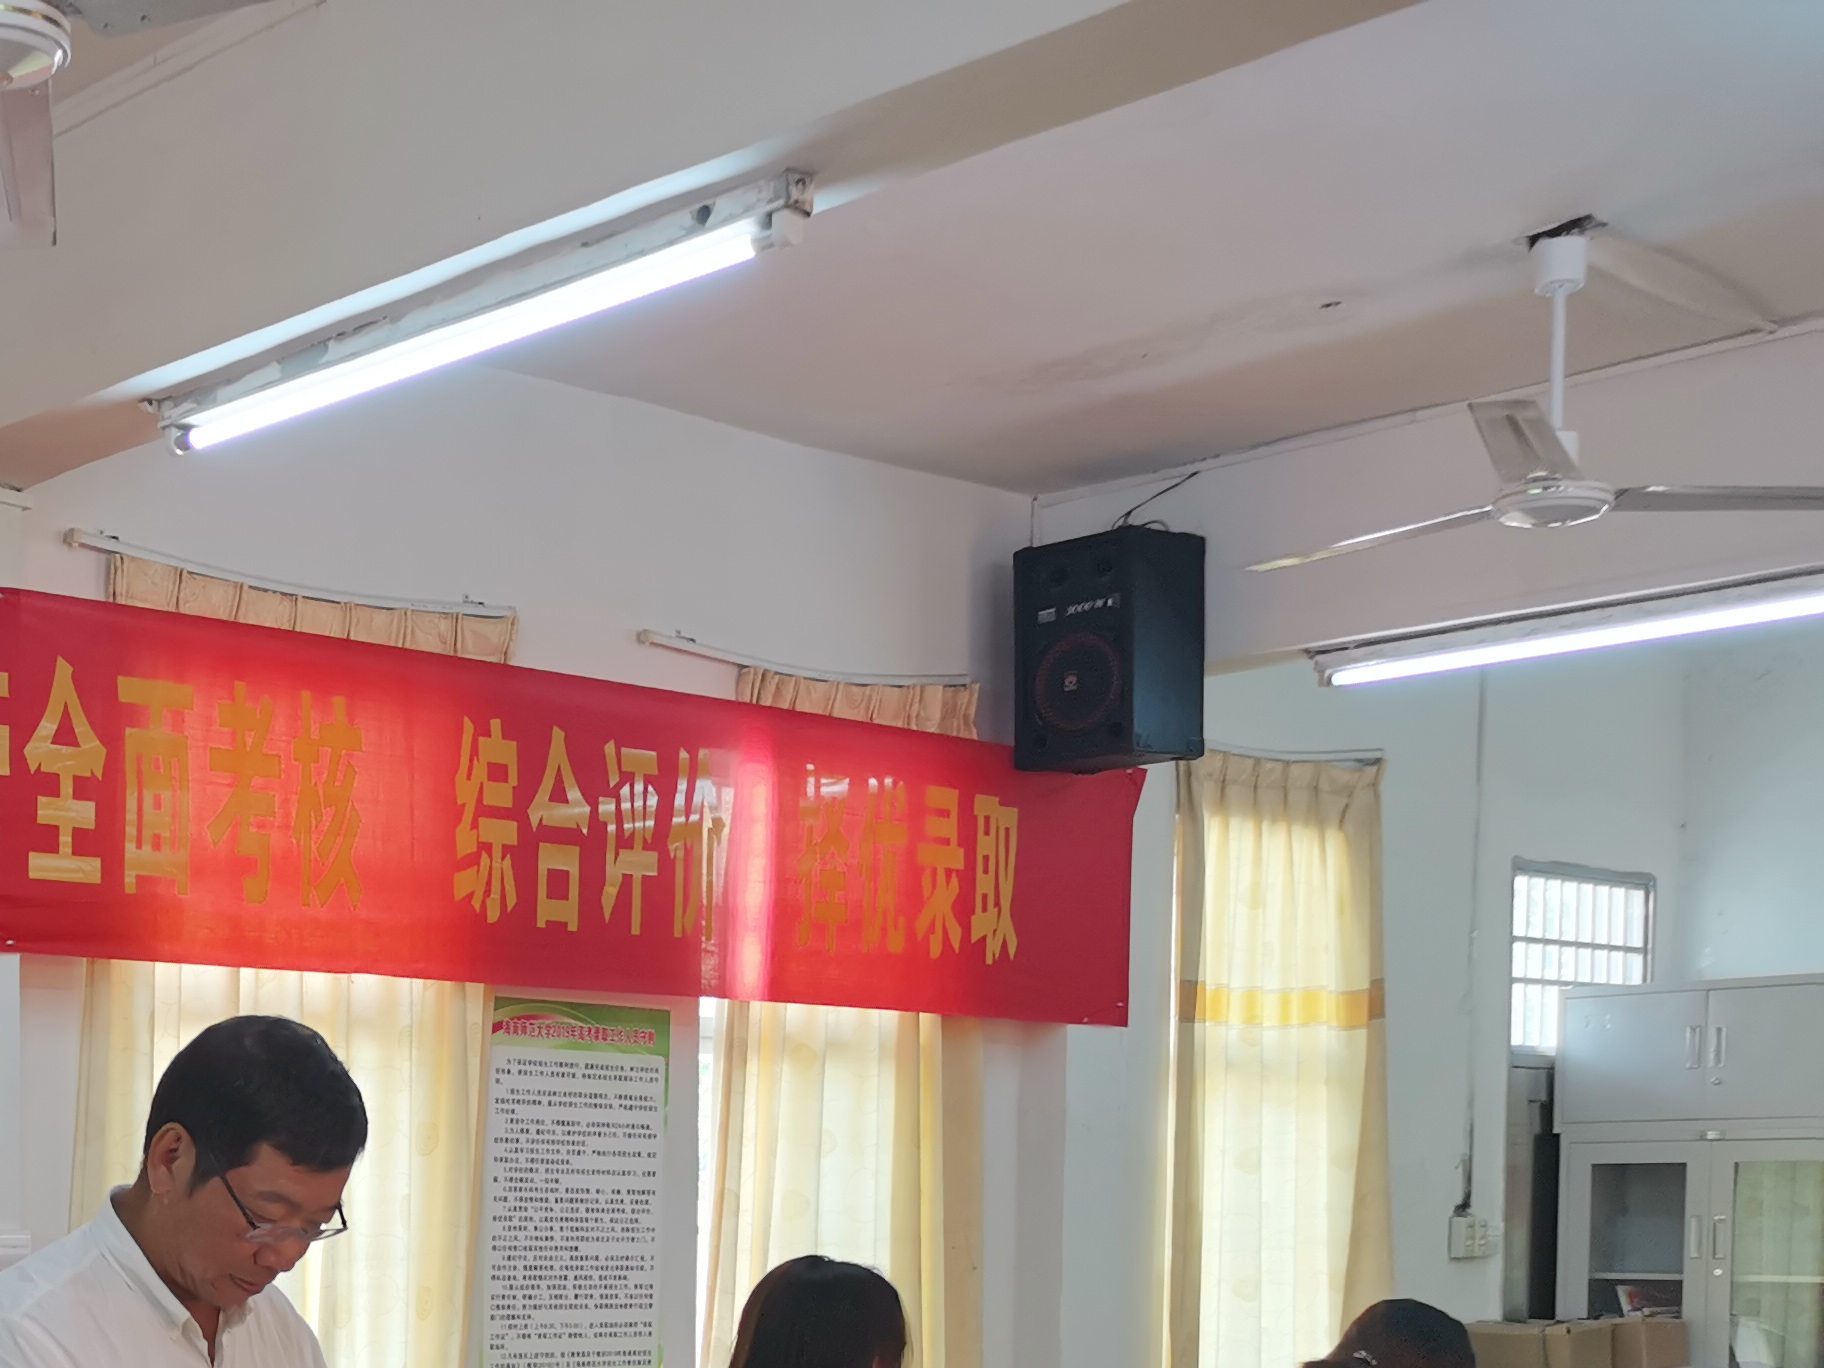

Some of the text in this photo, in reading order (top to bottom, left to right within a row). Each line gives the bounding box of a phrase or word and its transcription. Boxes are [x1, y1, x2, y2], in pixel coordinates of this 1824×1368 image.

[453, 716, 728, 942] 综合评价
[796, 763, 1020, 965] 择优录取
